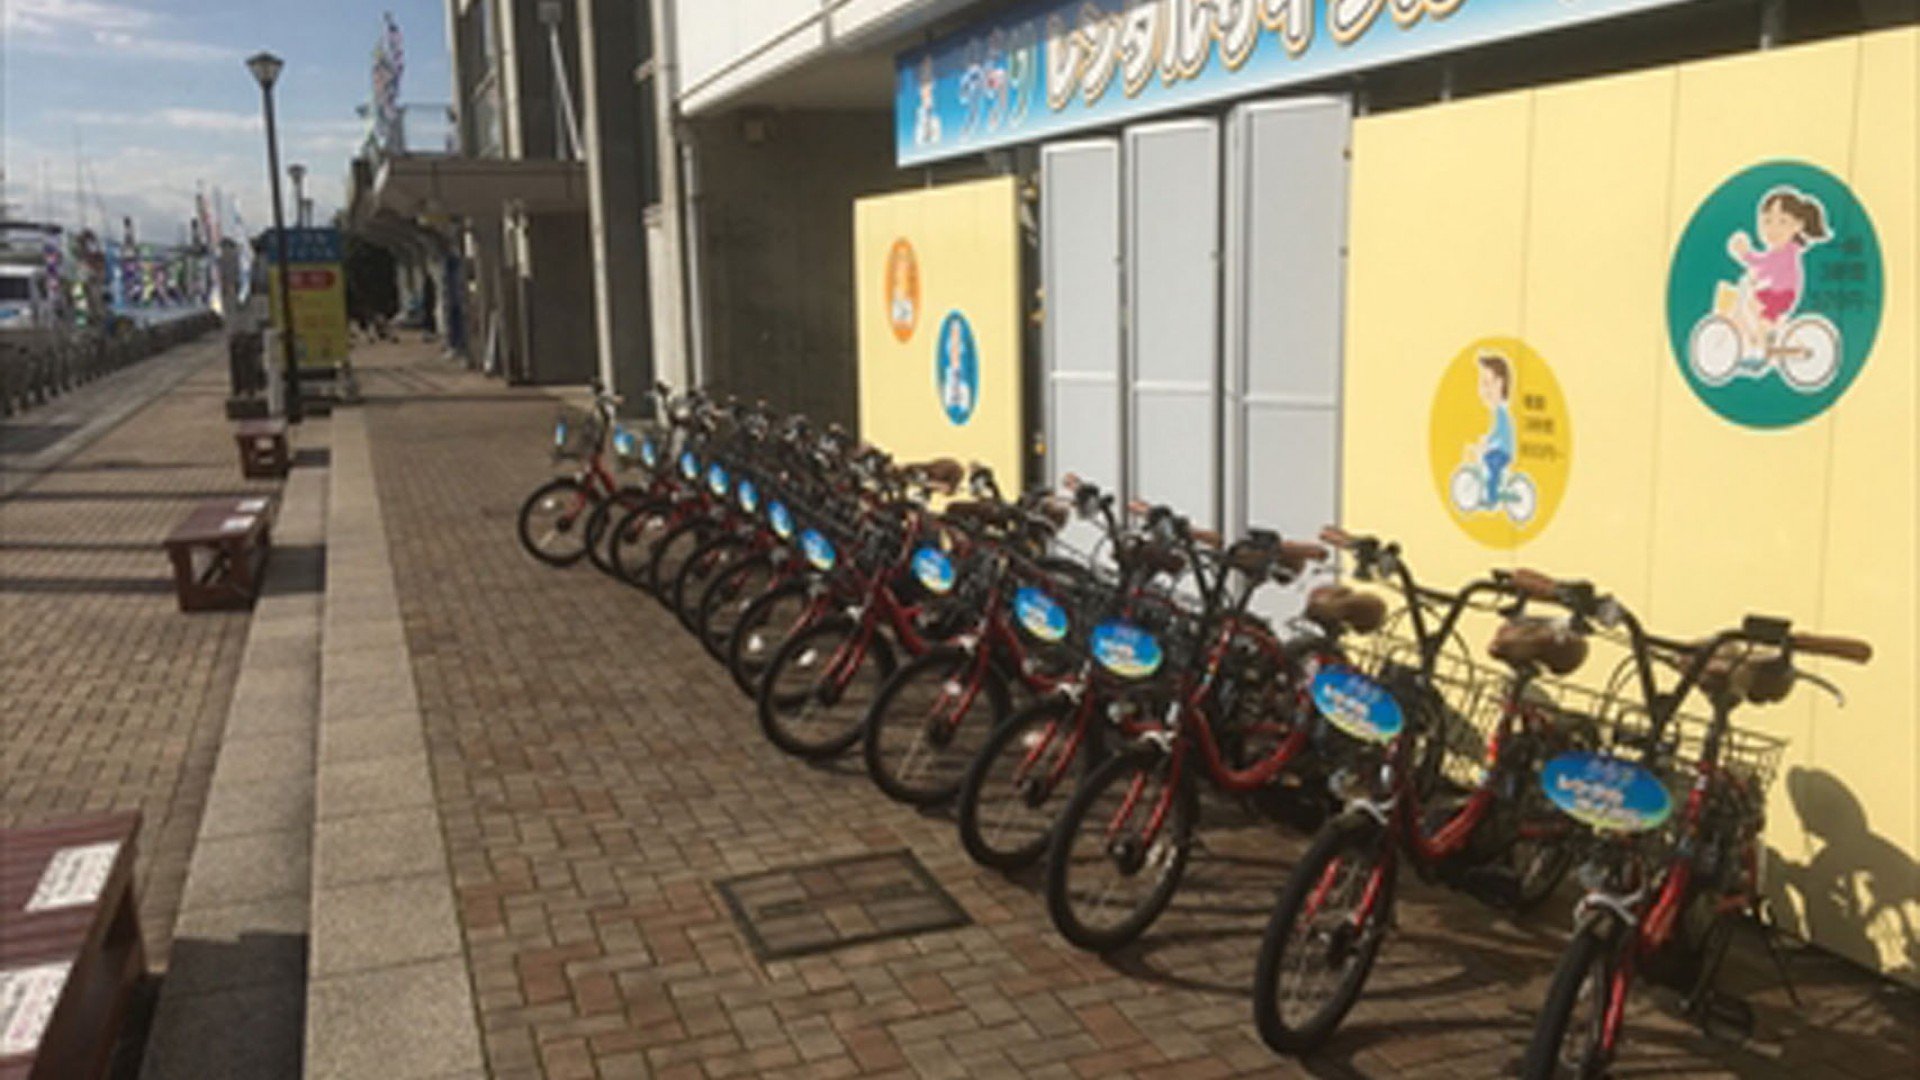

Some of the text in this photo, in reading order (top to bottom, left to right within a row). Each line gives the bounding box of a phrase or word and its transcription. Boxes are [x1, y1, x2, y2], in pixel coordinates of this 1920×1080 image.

[1047, 0, 1466, 113] レンタルサイ
